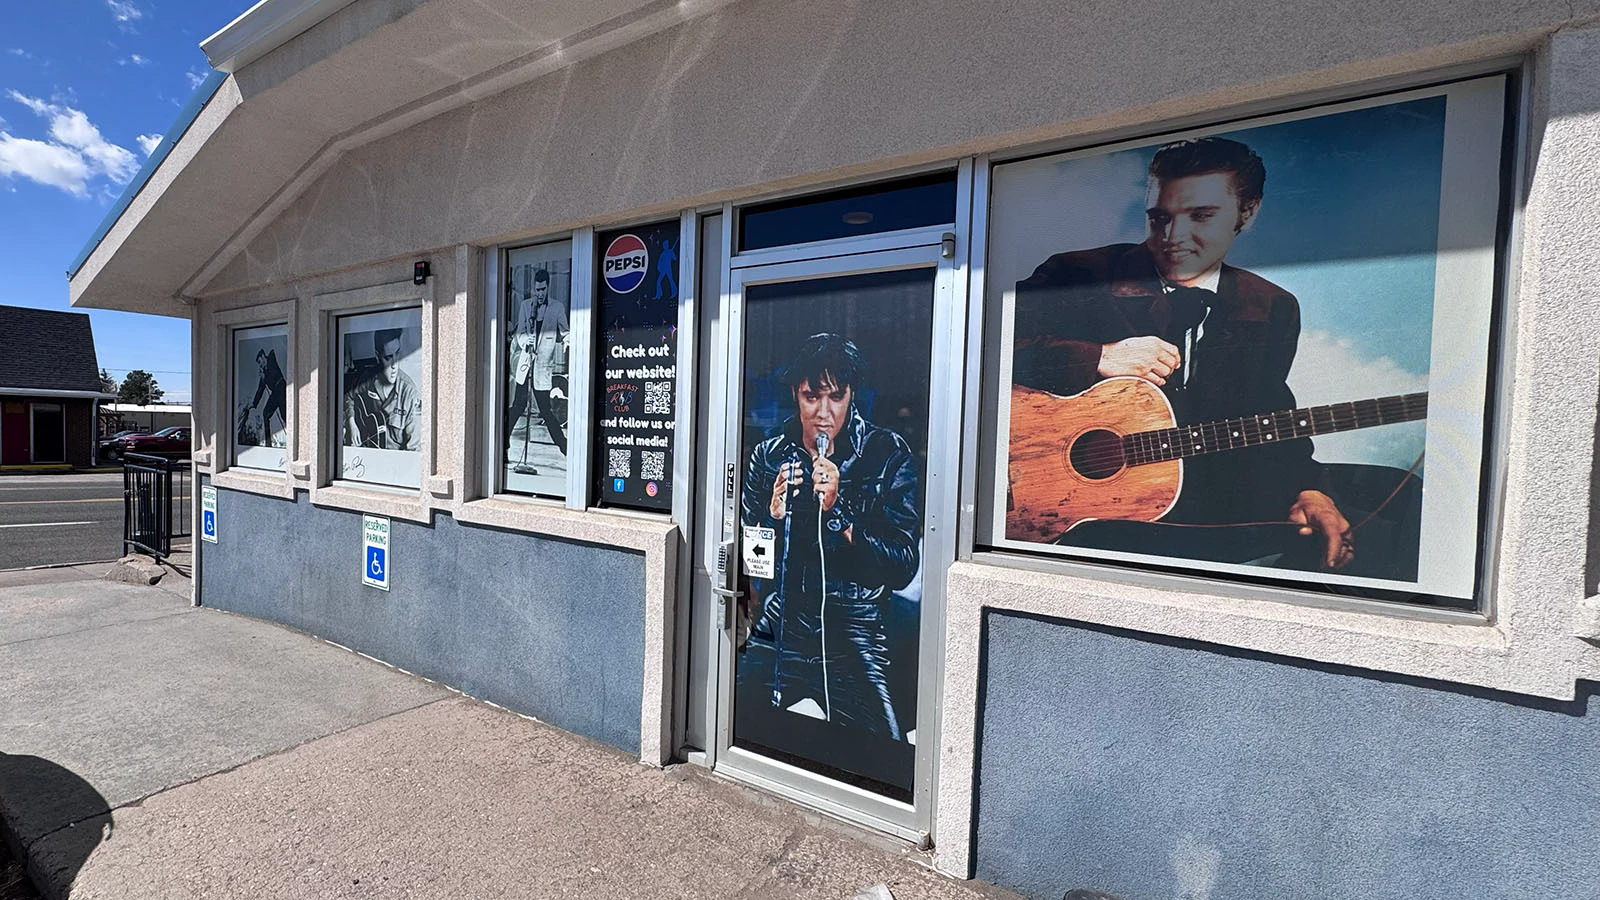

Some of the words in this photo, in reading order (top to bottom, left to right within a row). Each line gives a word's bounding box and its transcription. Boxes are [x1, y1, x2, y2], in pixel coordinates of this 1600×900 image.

[606, 256, 645, 272] PEPSI
[611, 344, 646, 358] Check
[648, 344, 670, 357] out
[605, 369, 624, 379] our
[626, 365, 675, 378] website!
[606, 384, 639, 393] BREAKFAST
[619, 417, 649, 428] follow
[651, 420, 663, 429] us
[607, 434, 634, 446] social
[636, 435, 668, 447] media!
[365, 520, 388, 533] RESERVED
[366, 532, 386, 545] PARKING
